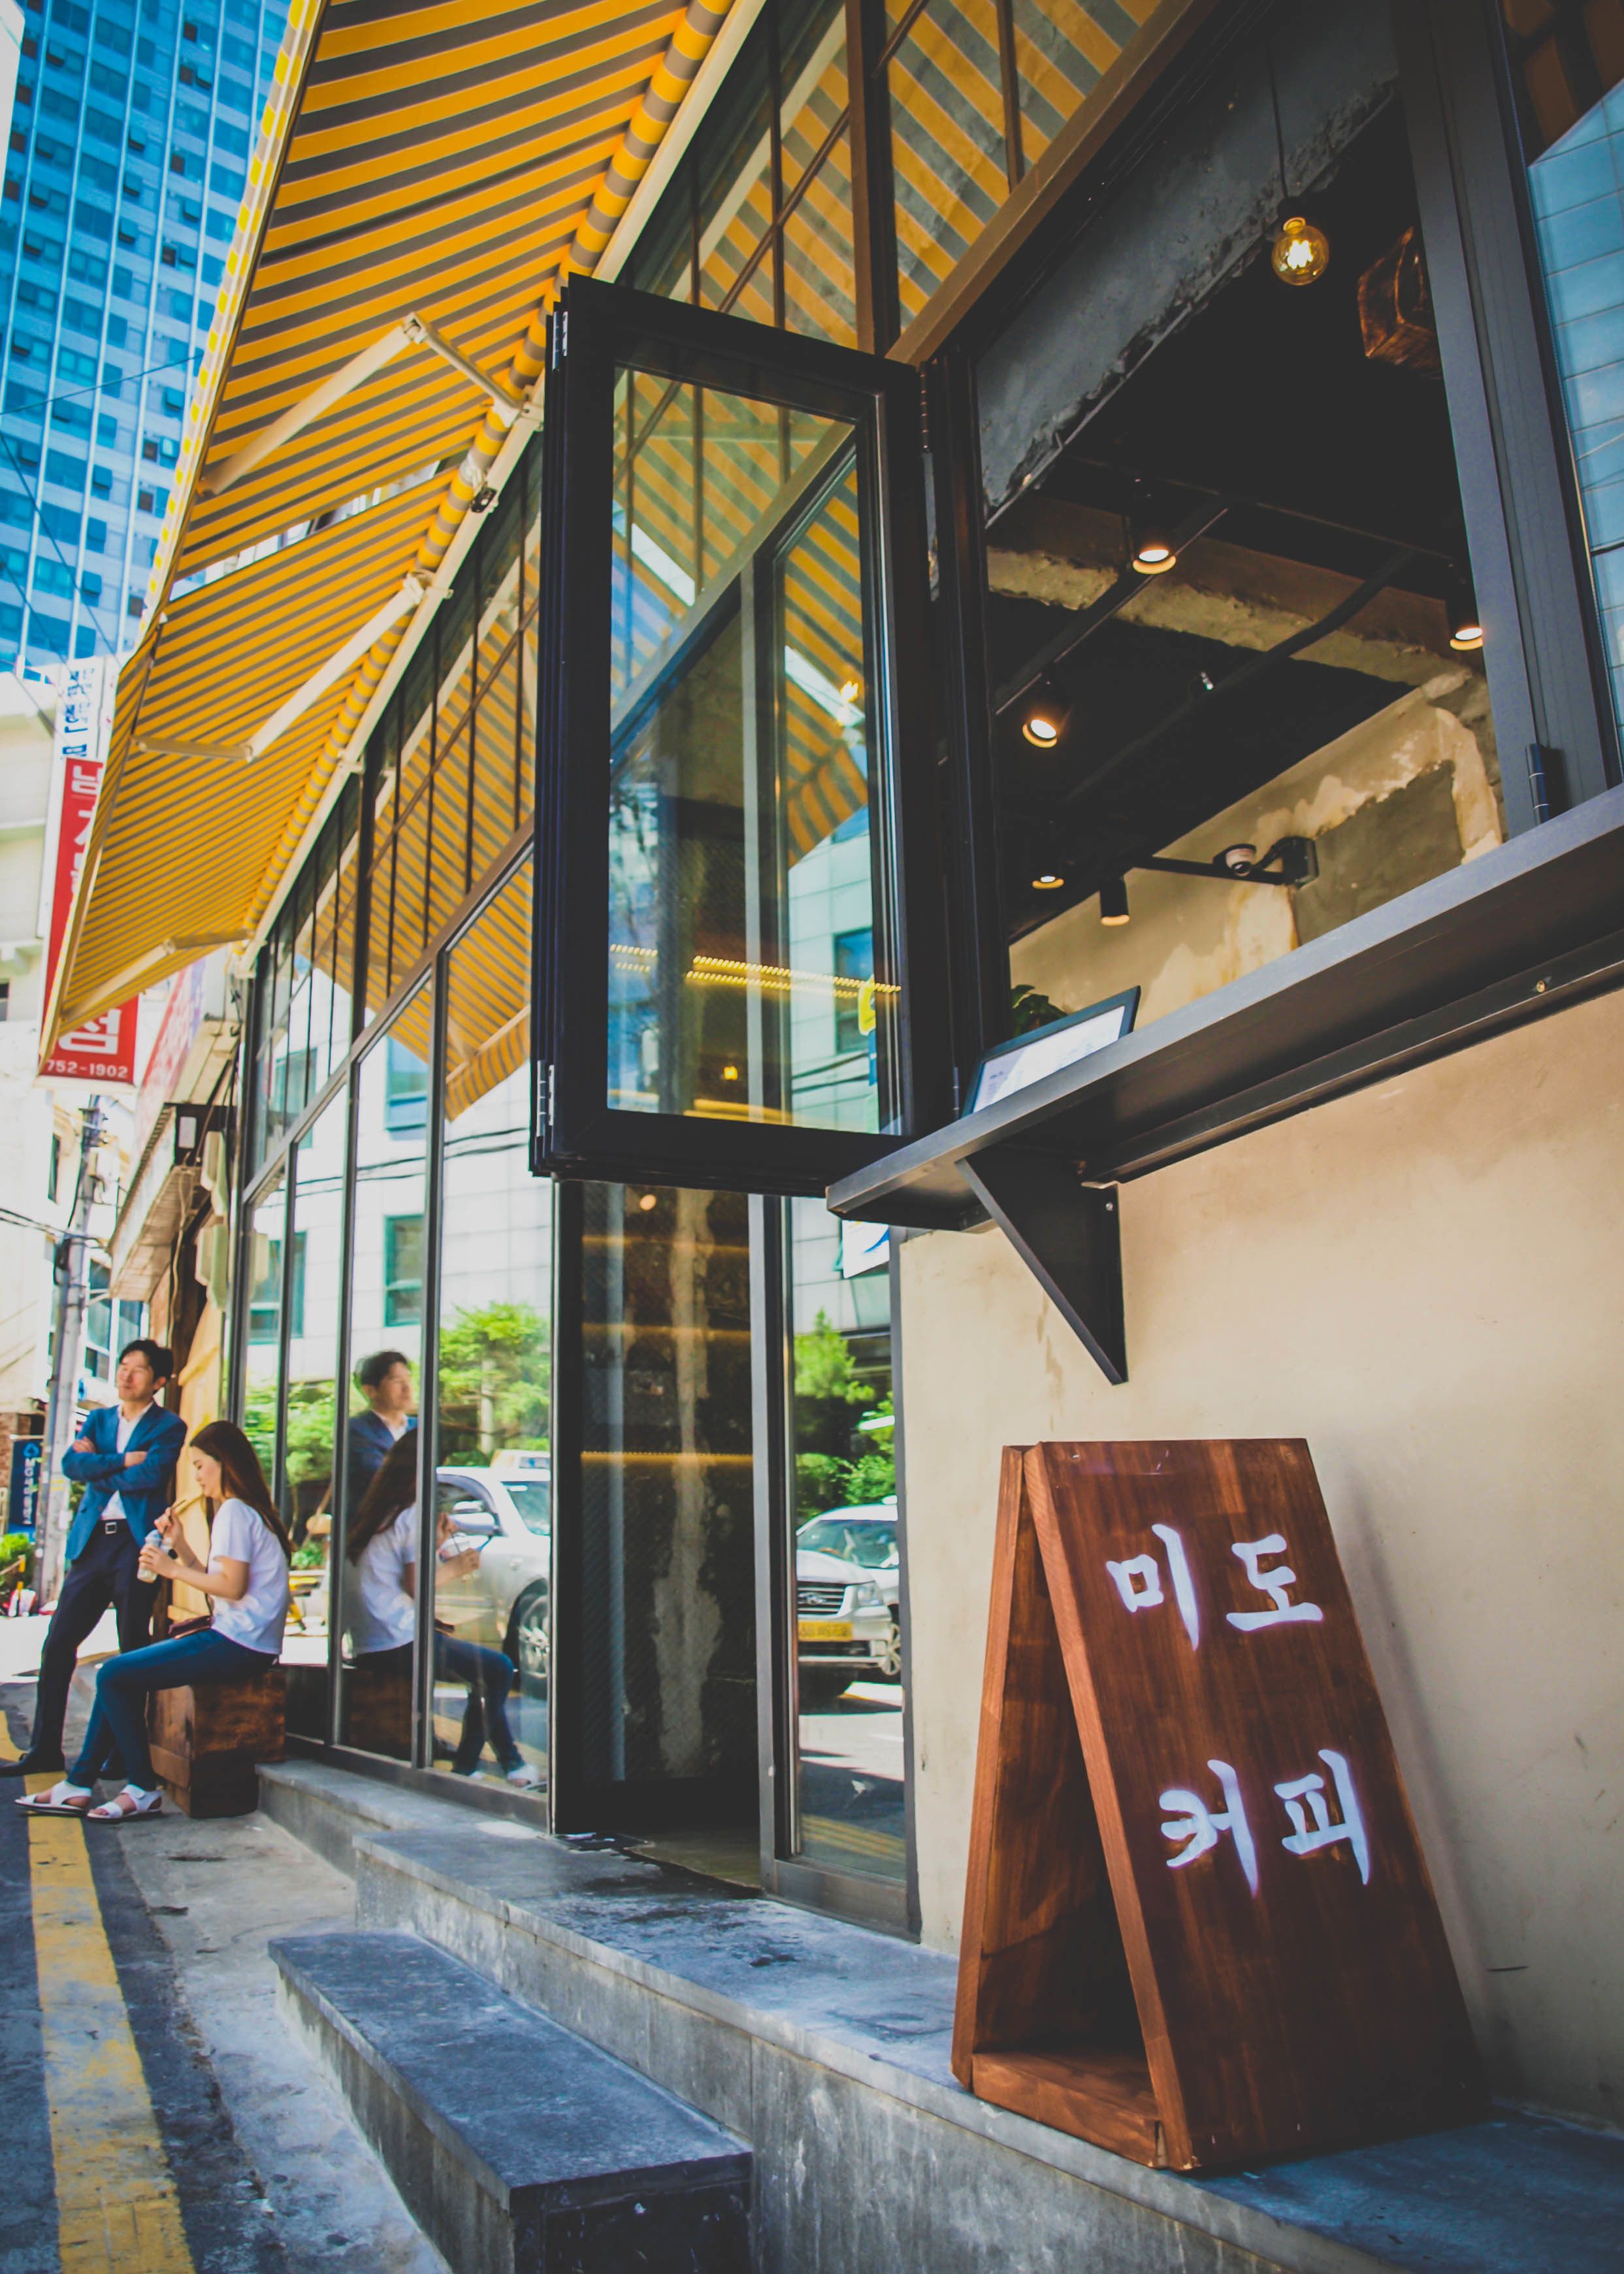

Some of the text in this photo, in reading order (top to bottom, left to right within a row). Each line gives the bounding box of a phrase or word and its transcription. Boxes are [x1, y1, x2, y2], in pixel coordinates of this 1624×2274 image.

[47, 1059, 128, 1078] 752-1902
[1105, 1523, 1324, 1651] 미도
[1159, 1749, 1370, 1899] 커피
